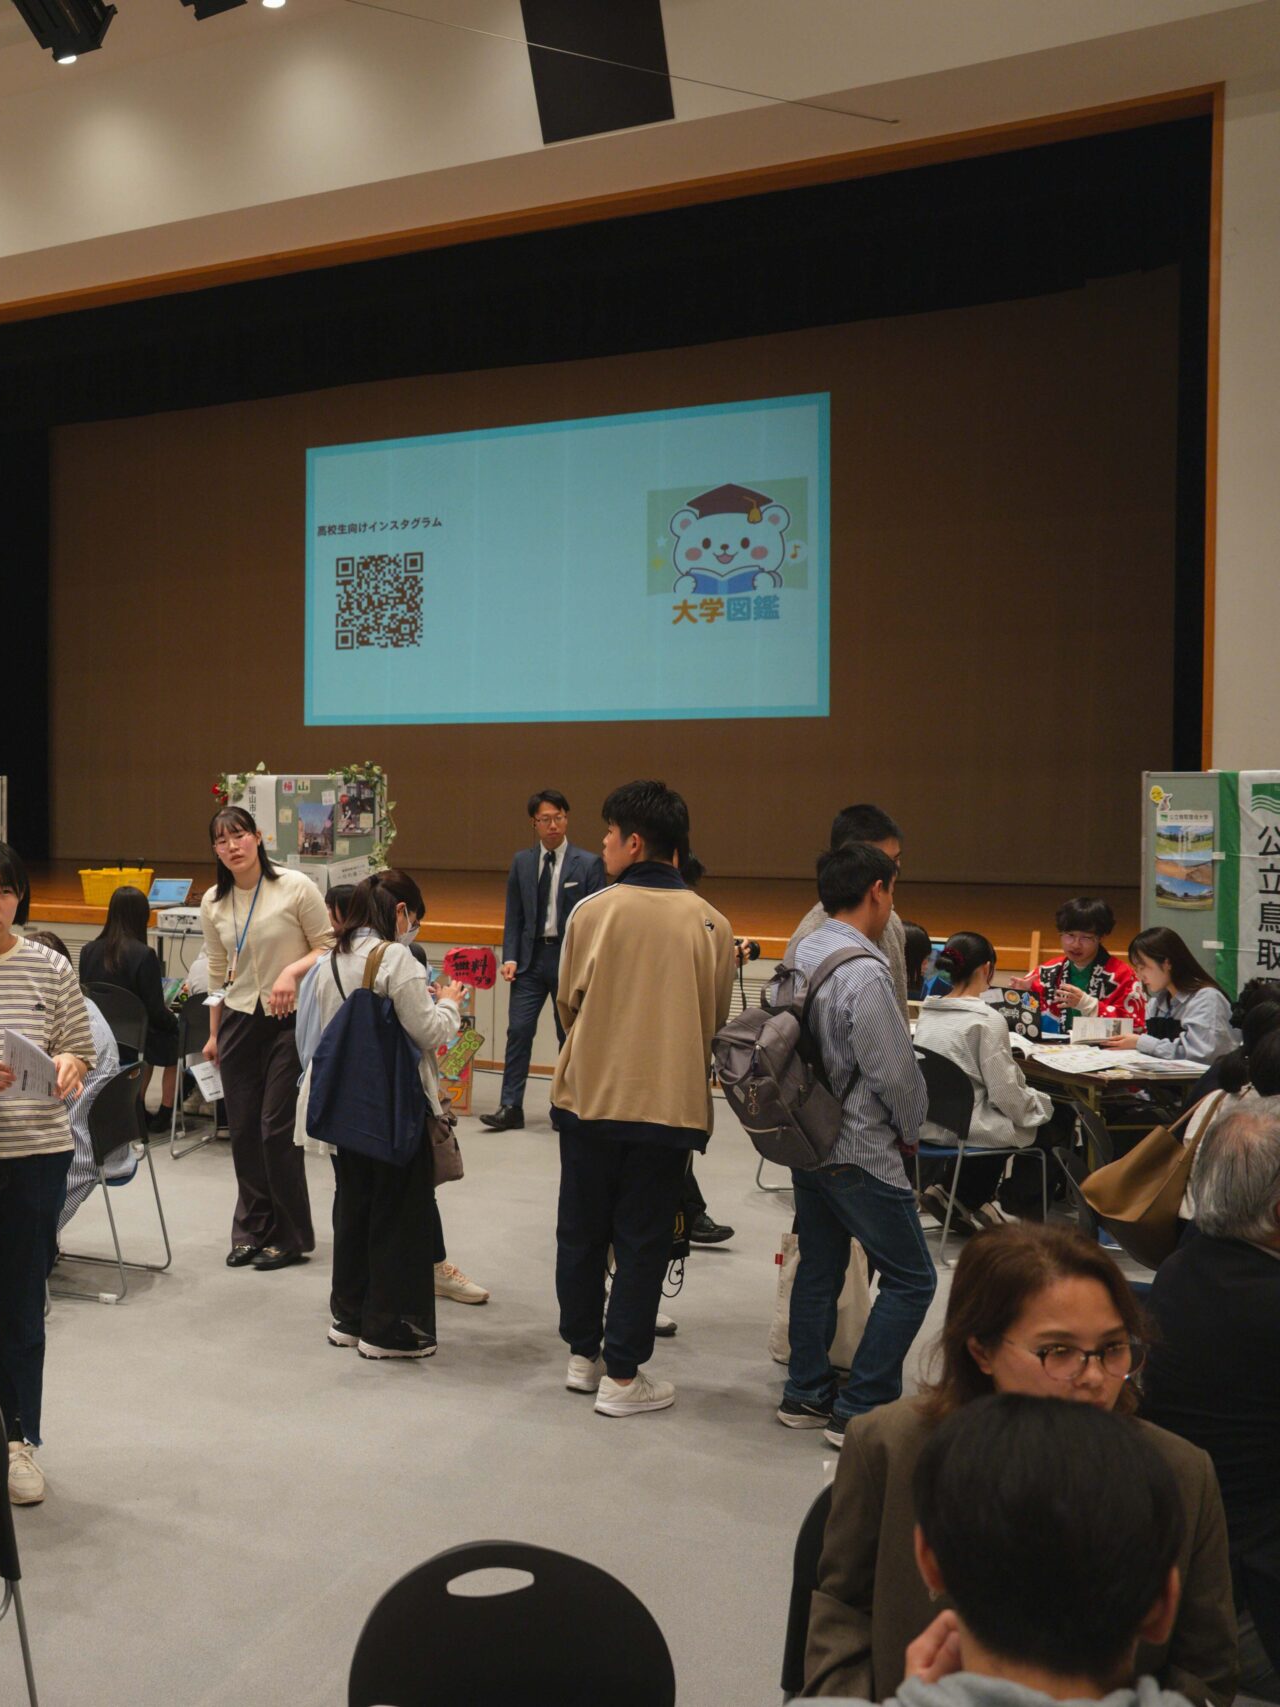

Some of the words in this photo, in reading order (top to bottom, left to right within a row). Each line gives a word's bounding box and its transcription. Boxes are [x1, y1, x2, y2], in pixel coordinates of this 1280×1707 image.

[317, 517, 442, 536] 高校生向けインスタグラム
[672, 594, 780, 625] 大学図鑑
[451, 952, 489, 977] 無料
